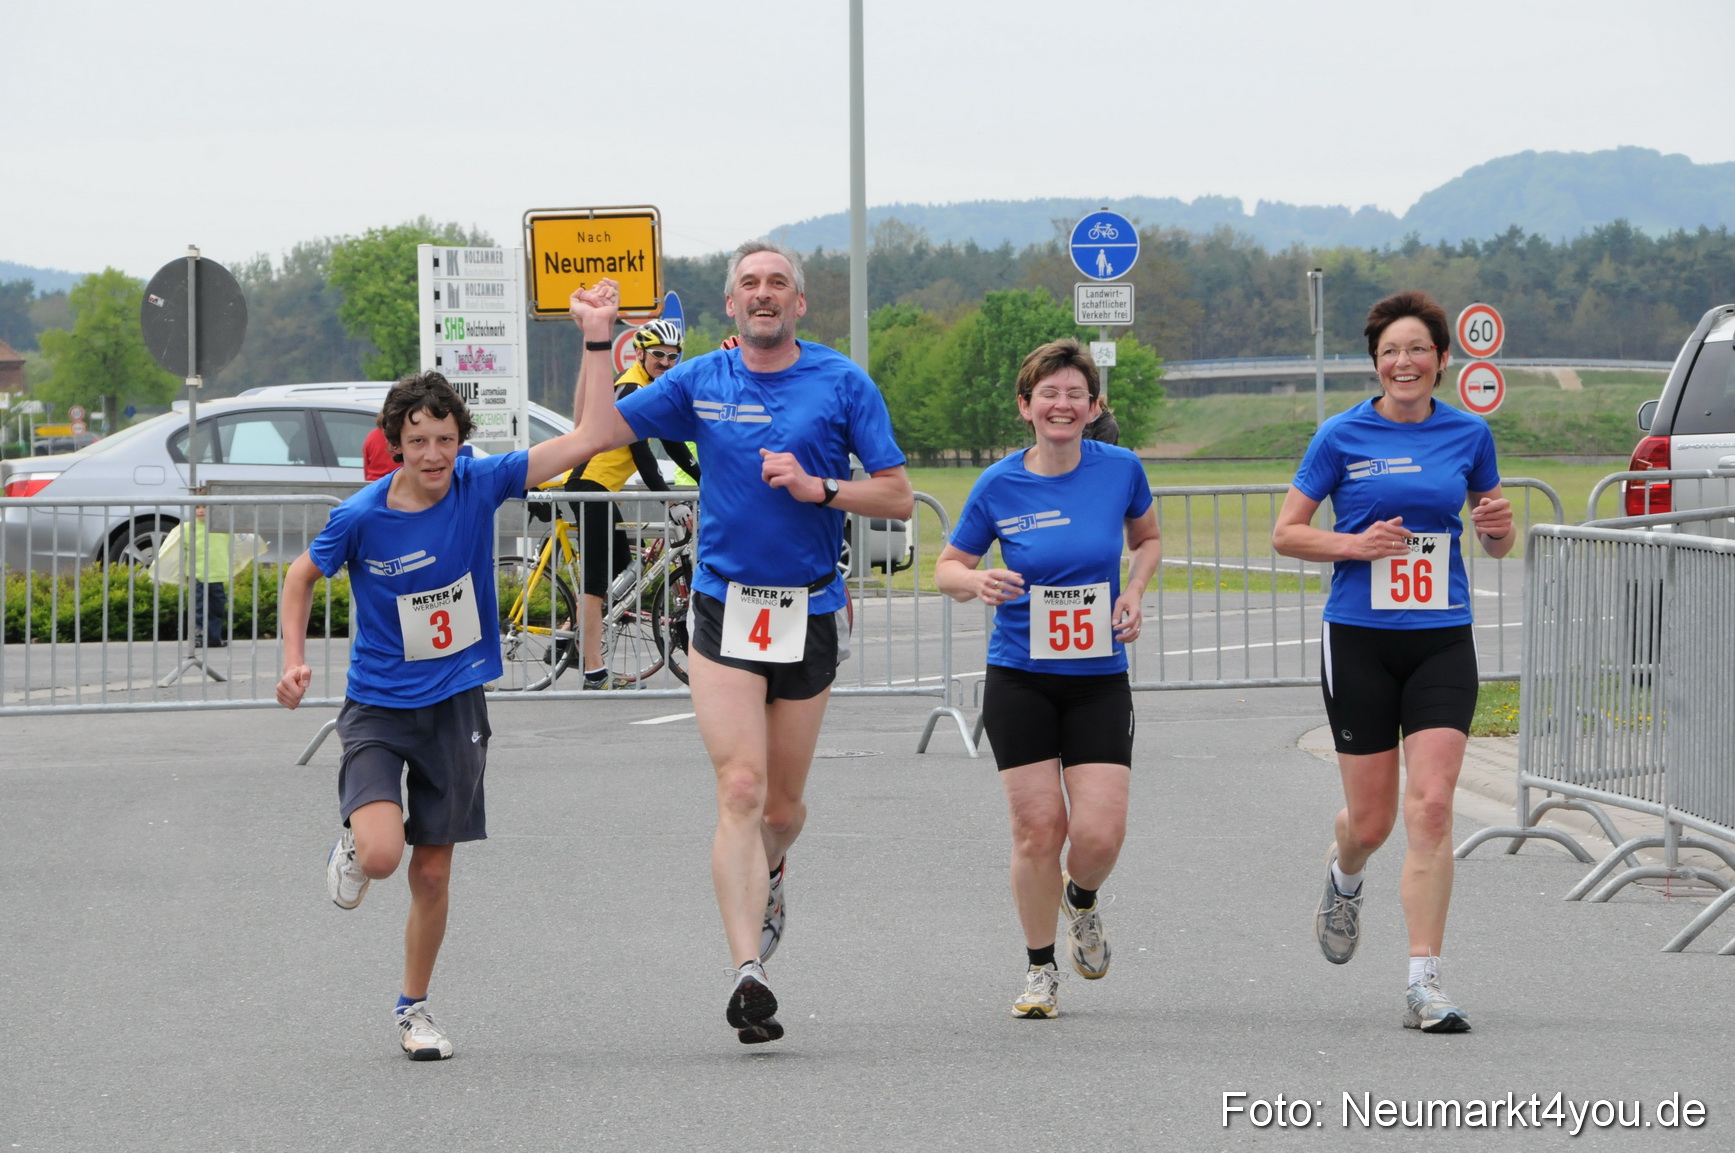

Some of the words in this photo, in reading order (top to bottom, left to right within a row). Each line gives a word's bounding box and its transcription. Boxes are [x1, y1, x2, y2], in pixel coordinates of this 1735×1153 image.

[577, 231, 612, 243] Nach
[464, 250, 504, 264] HOLZAMMER
[544, 249, 645, 274] Neumarkt
[465, 282, 505, 297] HOLZAMMER
[1085, 289, 1123, 299] Landwirt-
[1081, 300, 1127, 309] schaftlicher
[1082, 311, 1111, 320] Verkehr
[1114, 310, 1128, 319] frei
[444, 317, 465, 341] SHB
[1468, 320, 1493, 342] 60
[1390, 558, 1432, 603] 56
[412, 590, 450, 606] MEYER
[741, 586, 778, 599] MEYER
[1043, 590, 1080, 599] MEYER
[413, 599, 451, 612] WERBUNG
[741, 596, 778, 607] WERBUNG
[1043, 598, 1082, 606] WERBUNG
[429, 609, 453, 650] 3
[748, 608, 772, 651] 4
[1049, 608, 1094, 651] 55
